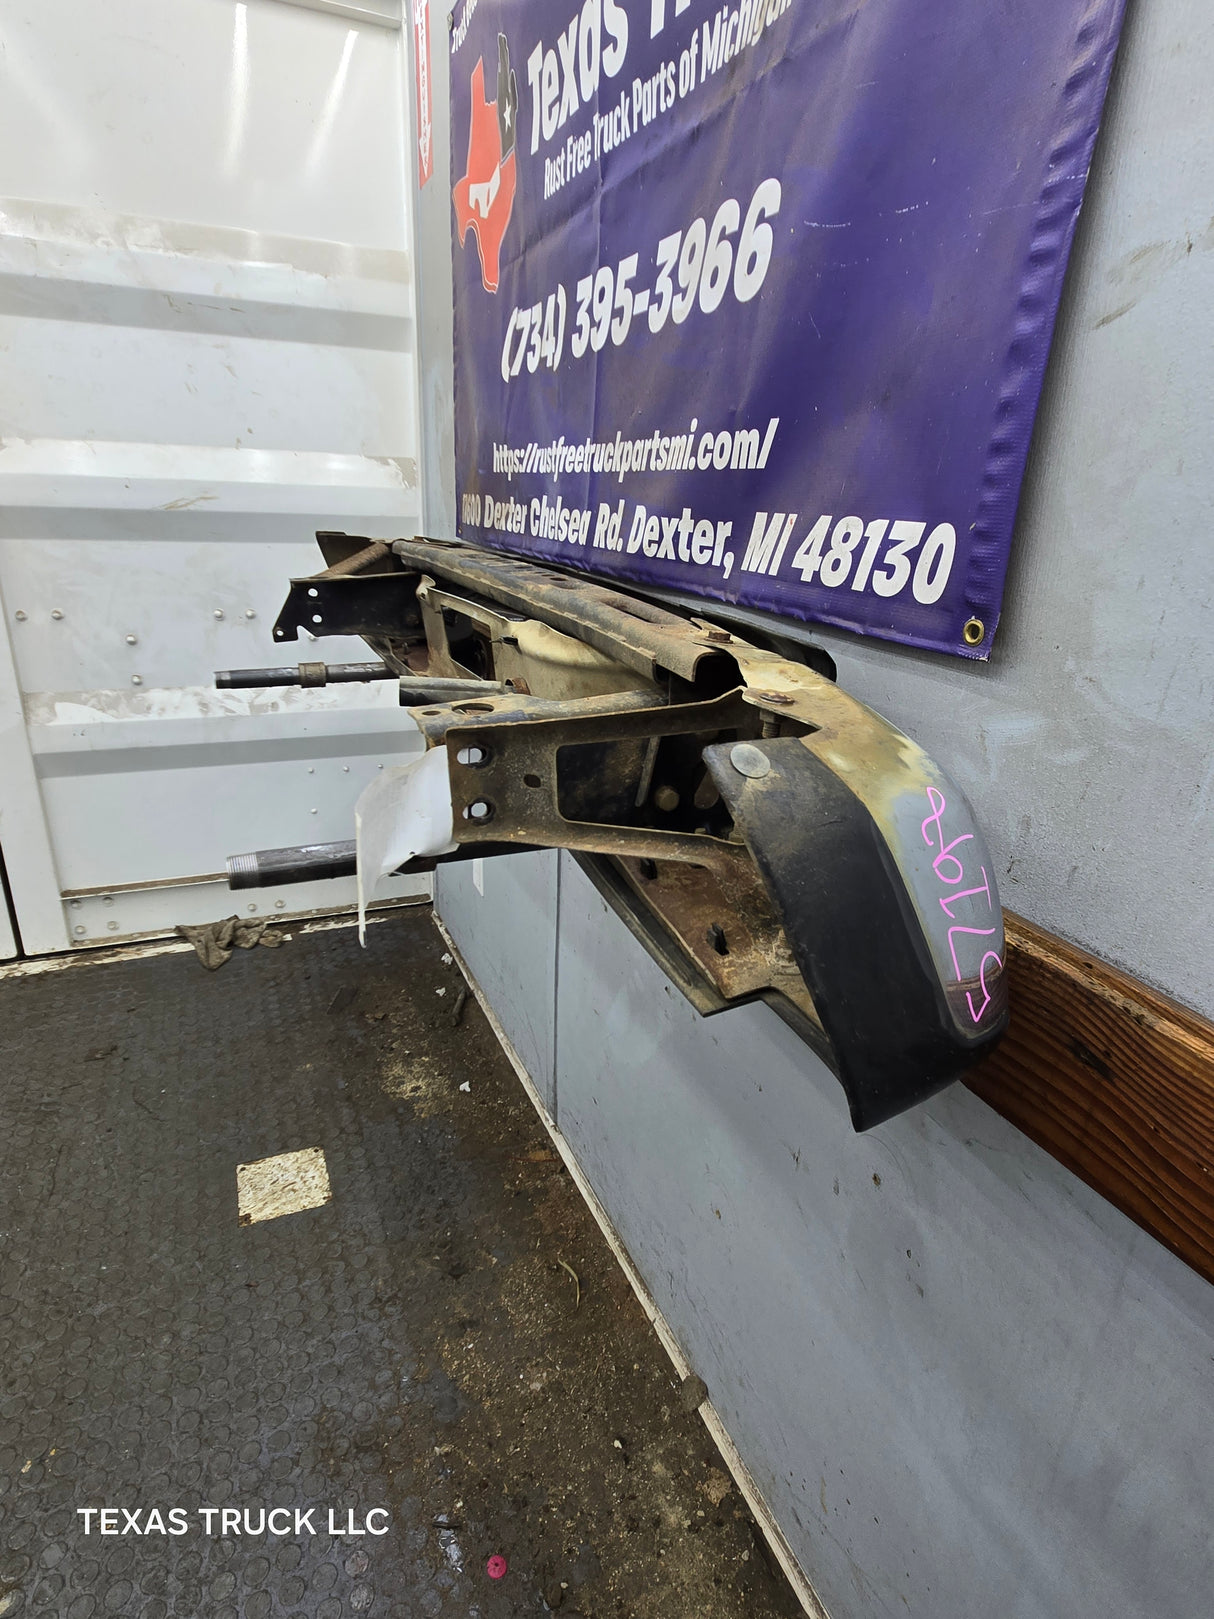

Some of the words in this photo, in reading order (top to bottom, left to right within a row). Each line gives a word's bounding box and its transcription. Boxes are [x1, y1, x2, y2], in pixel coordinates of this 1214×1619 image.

[527, 0, 629, 156] Texas
[544, 147, 566, 200] Rust
[566, 130, 592, 183] Free
[593, 90, 630, 162] Truck
[632, 60, 676, 134] Parts
[679, 28, 699, 98] of
[501, 283, 566, 383] (734)
[571, 178, 782, 359] 395-3966
[492, 417, 780, 483] https://rustfreetruckpartsmi.com/
[484, 495, 527, 535] Dexter
[530, 495, 591, 548] Chelsea
[593, 499, 623, 553] Rd.
[627, 505, 733, 579] Dexter,
[741, 511, 799, 577] MI
[792, 514, 957, 605] 48130
